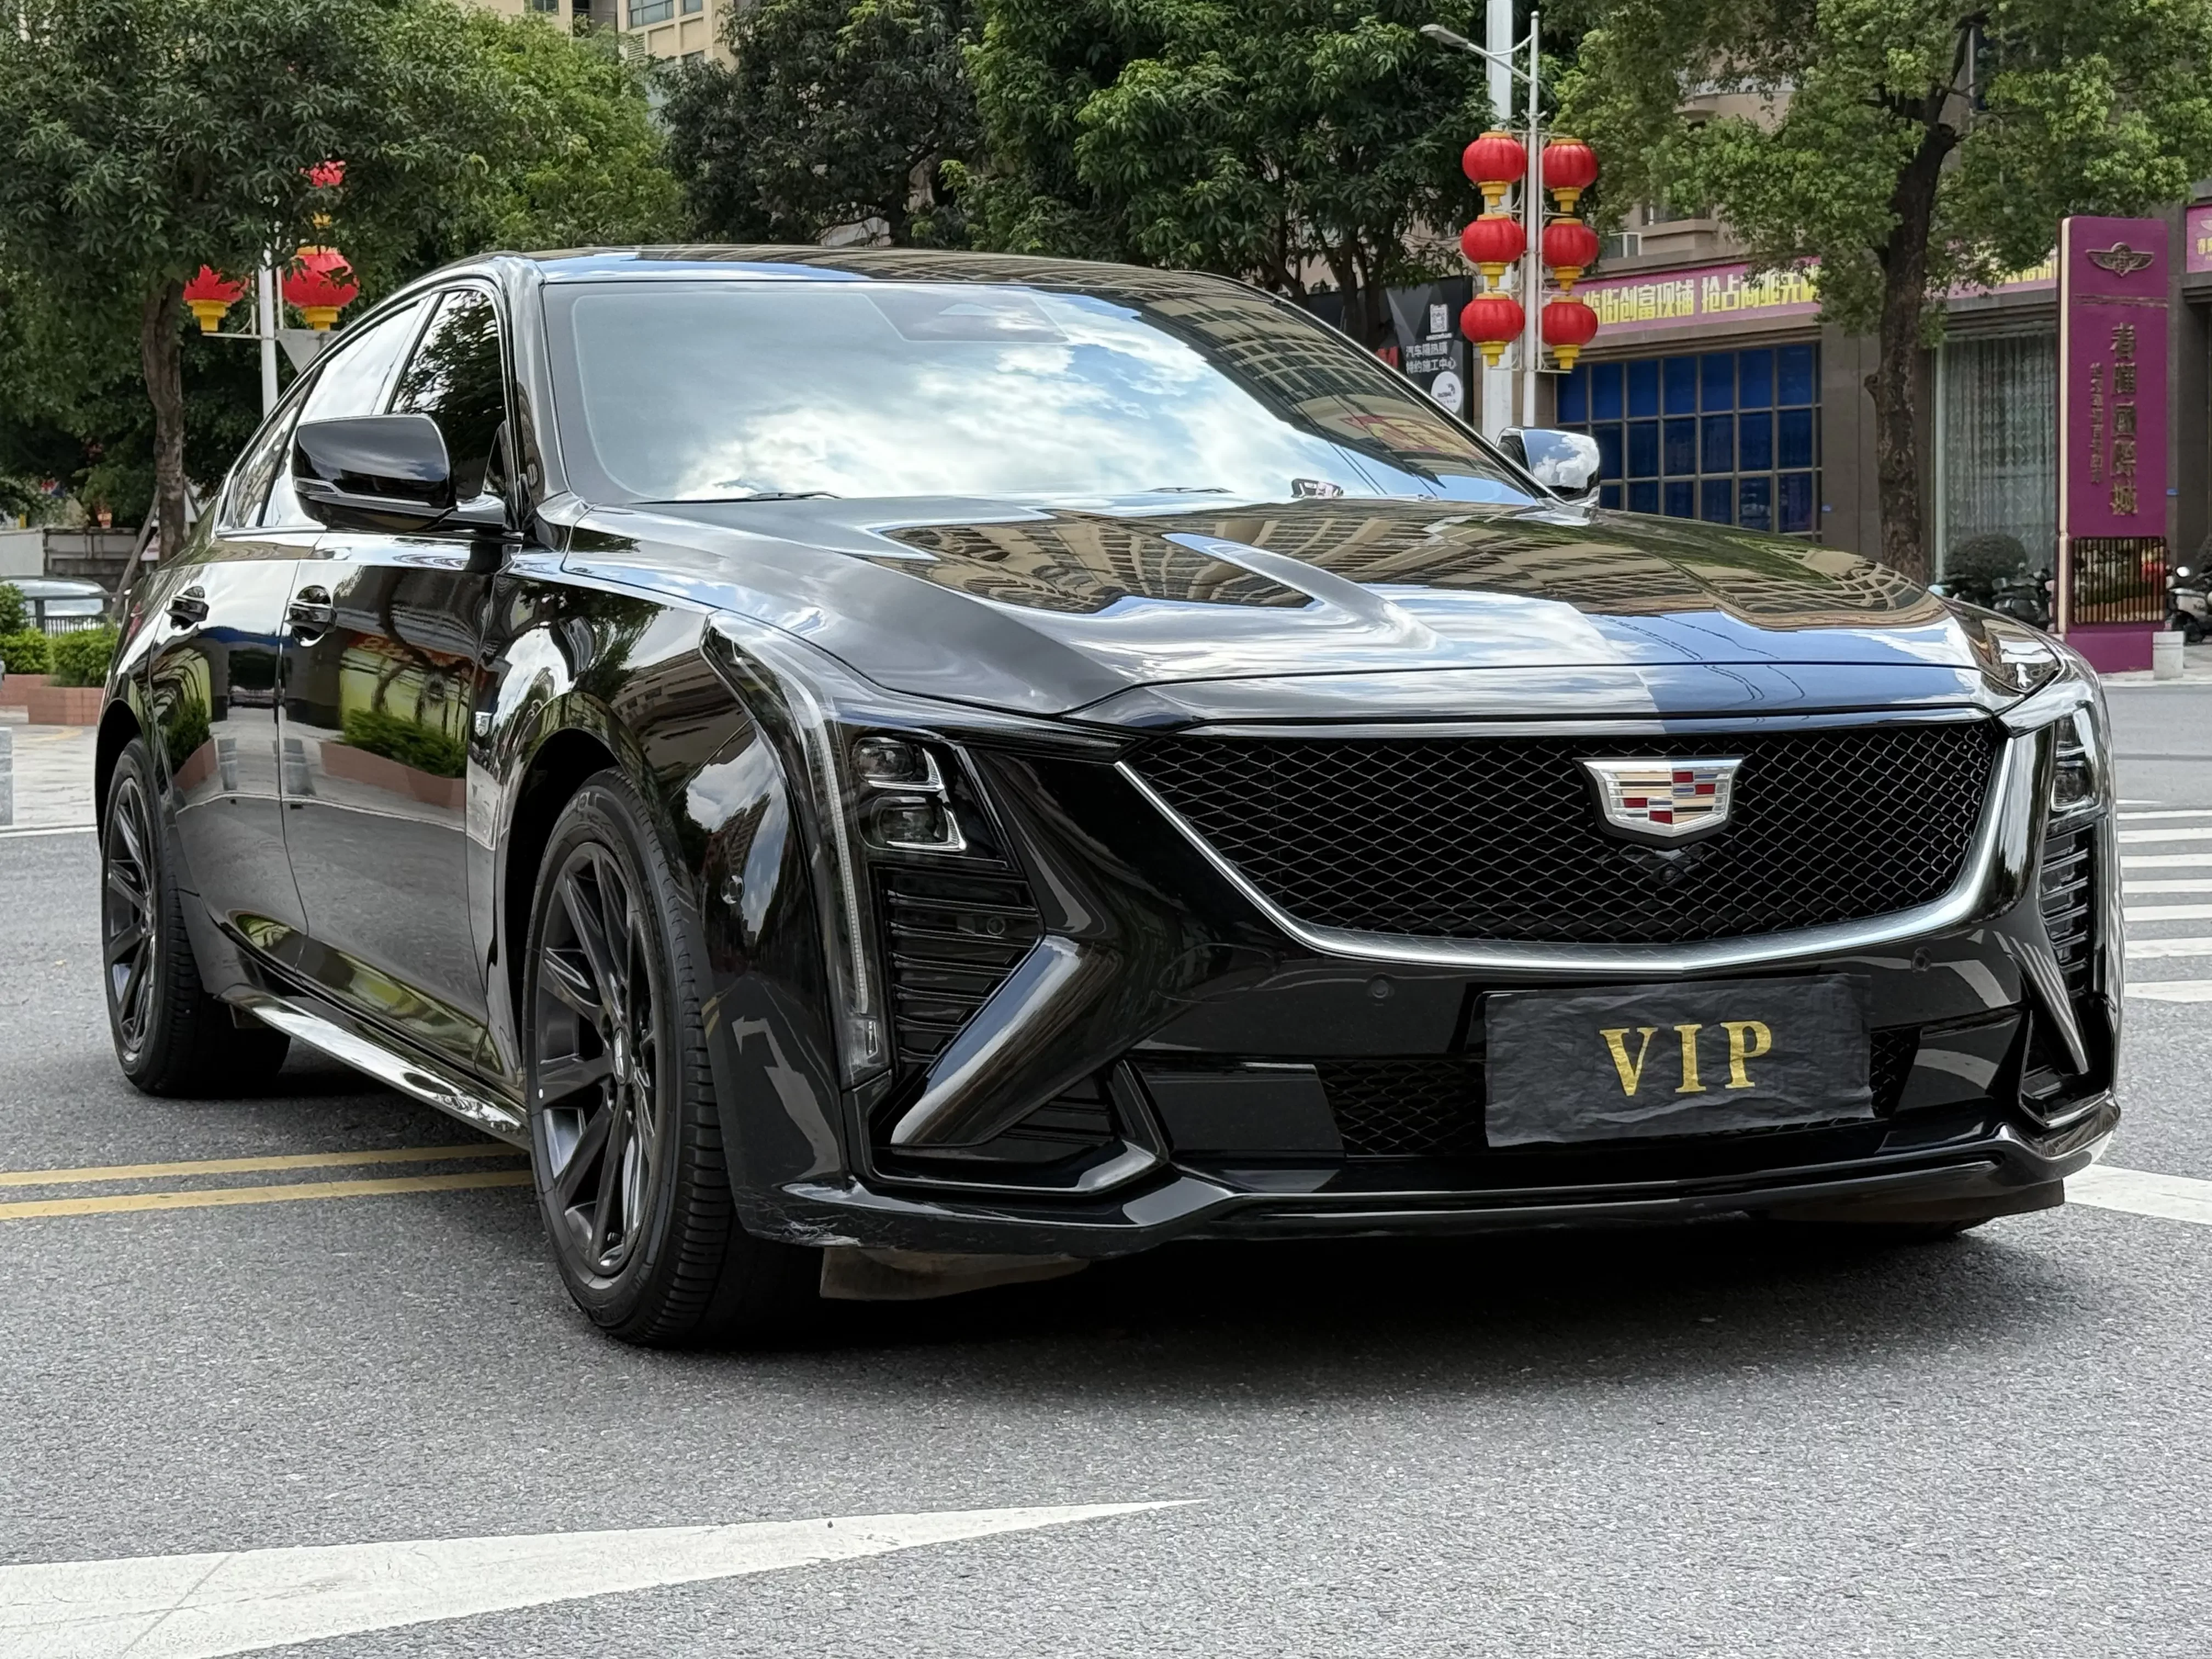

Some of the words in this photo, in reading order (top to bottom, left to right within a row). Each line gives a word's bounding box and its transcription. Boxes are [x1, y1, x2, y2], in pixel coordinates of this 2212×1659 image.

[1406, 357, 1457, 374] 特约施工中心
[1599, 1020, 1772, 1096] VIP
